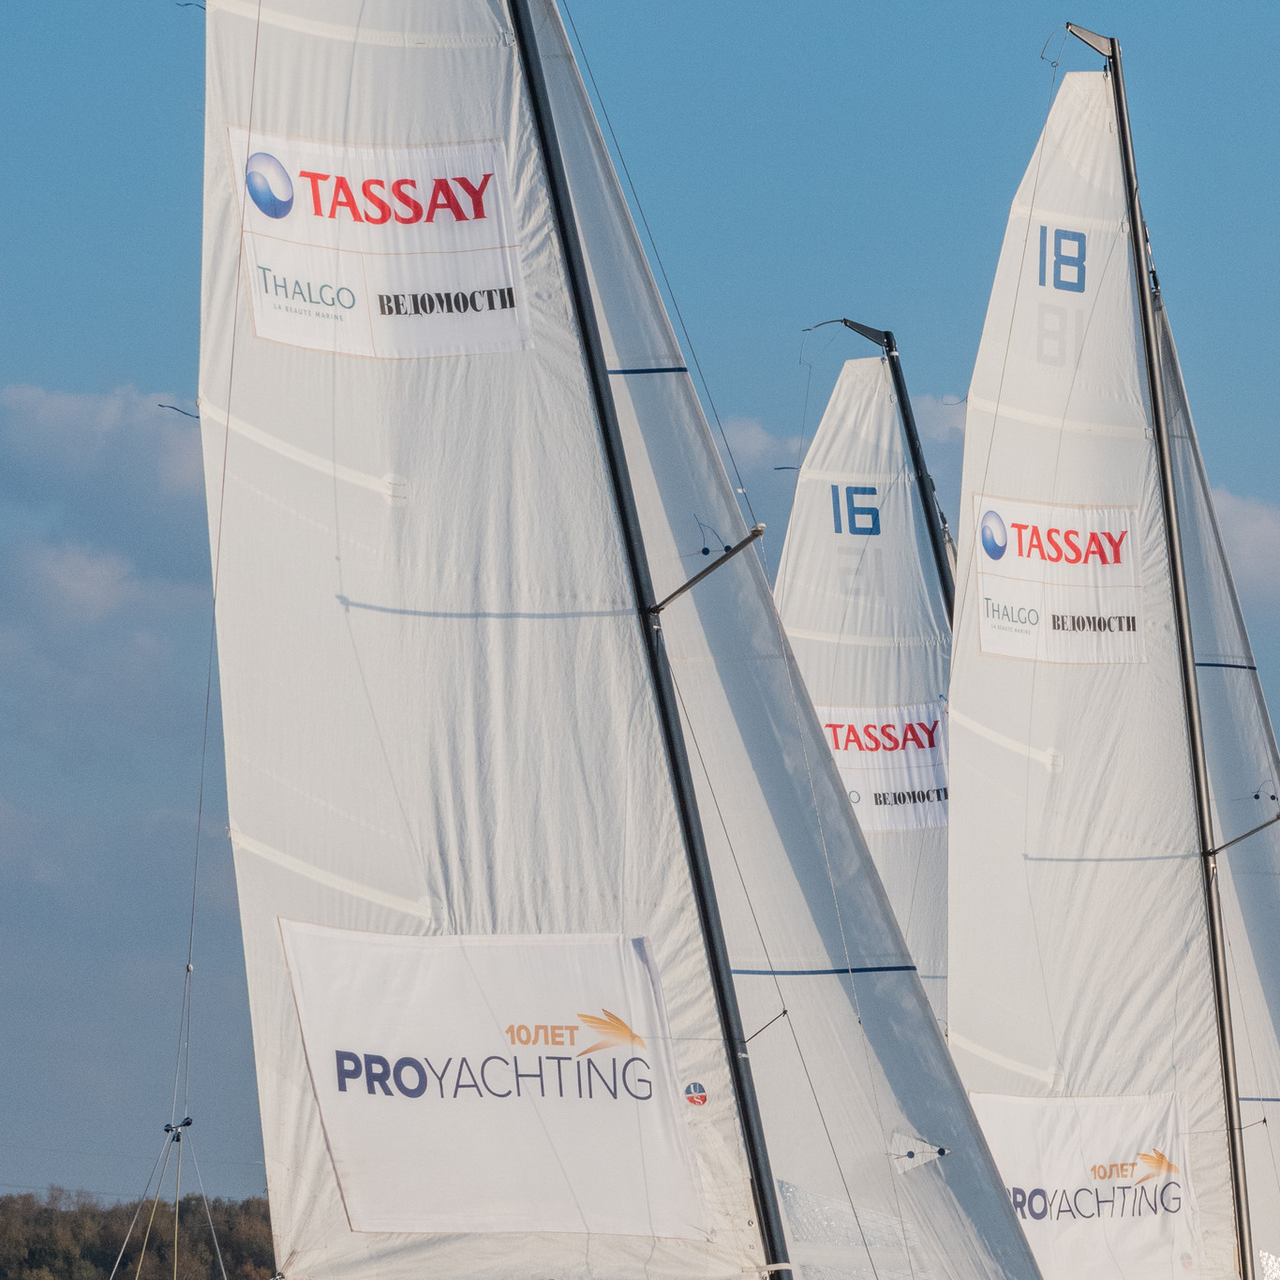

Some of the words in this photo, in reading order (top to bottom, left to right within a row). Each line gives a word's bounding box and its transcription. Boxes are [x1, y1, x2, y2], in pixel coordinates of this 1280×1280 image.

[298, 170, 495, 225] TASSAY
[1038, 225, 1087, 293] 18
[257, 264, 356, 310] THALGO
[377, 287, 517, 317] ВЕДОМОСТИ
[315, 311, 344, 322] MARINE
[830, 484, 881, 536] 16
[1010, 521, 1129, 565] TASSAY
[984, 597, 1039, 626] THALGO
[1051, 613, 1137, 633] ВЕДОМОСТИ
[824, 720, 940, 752] TASSAY
[335, 1049, 652, 1101] PROYACHTING
[1006, 1181, 1182, 1221] ROYACHTING
